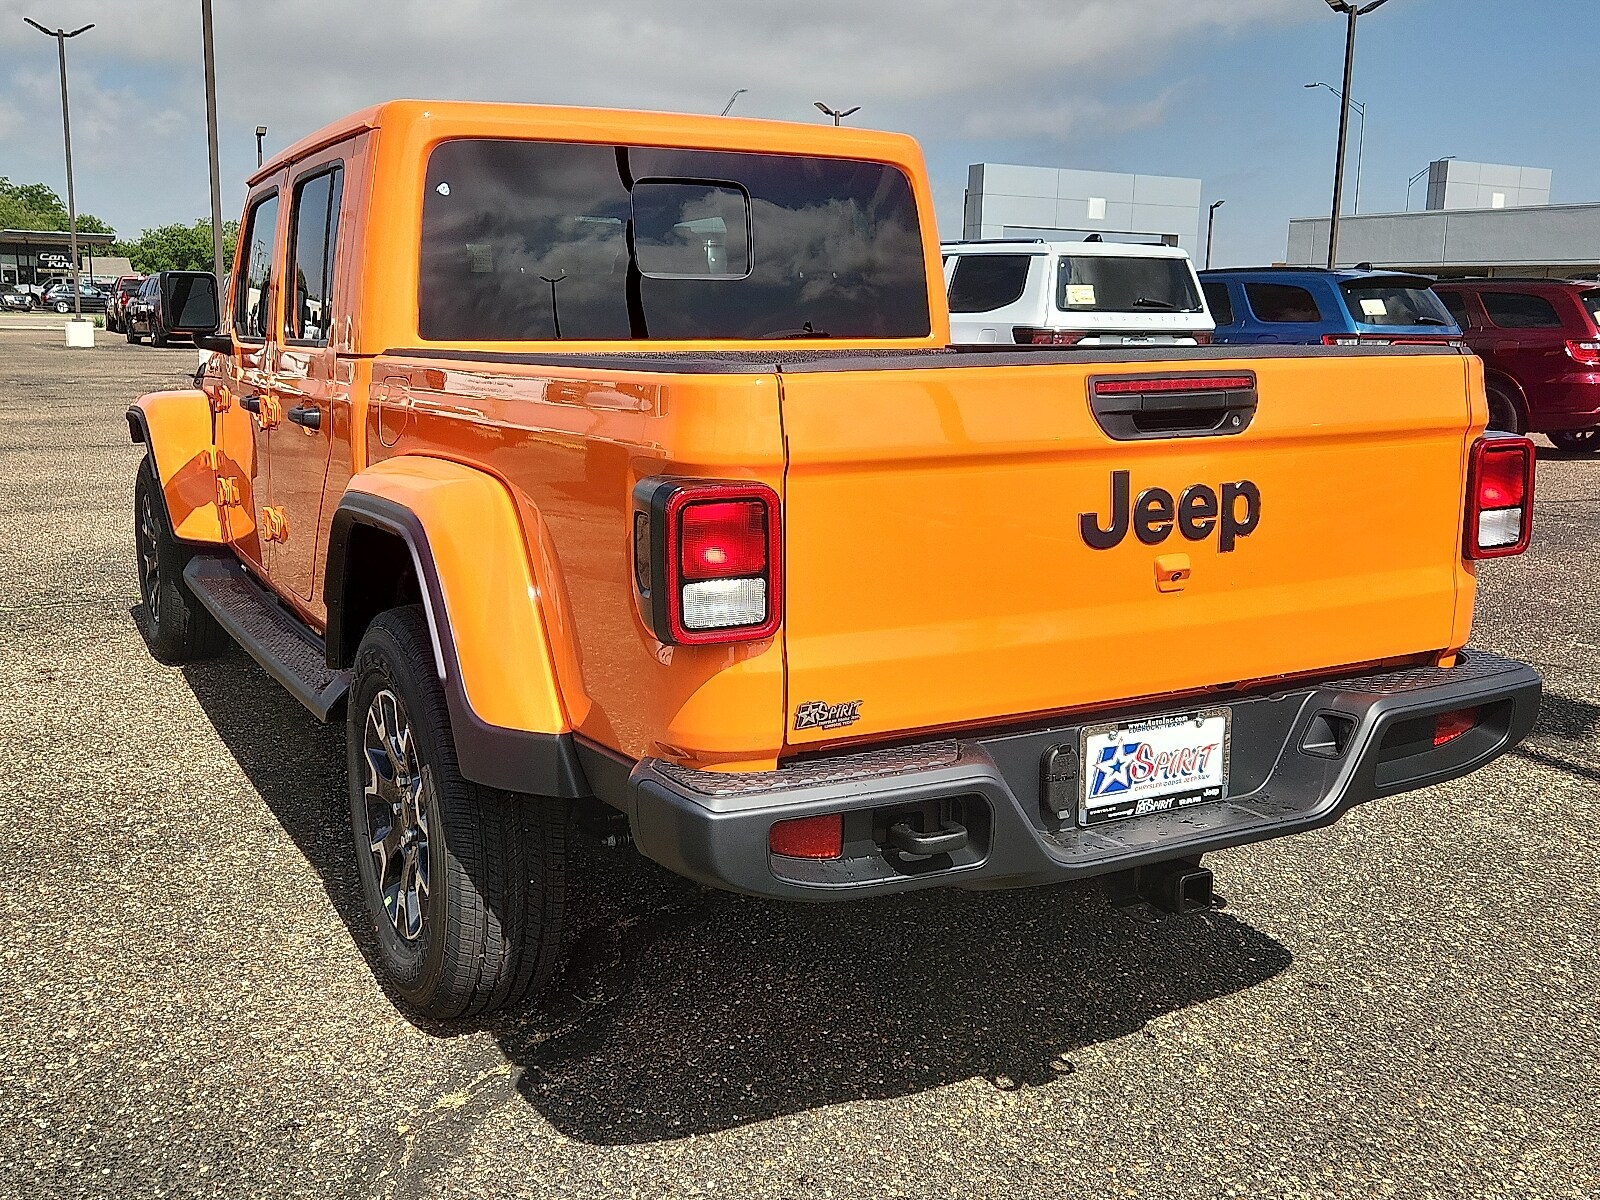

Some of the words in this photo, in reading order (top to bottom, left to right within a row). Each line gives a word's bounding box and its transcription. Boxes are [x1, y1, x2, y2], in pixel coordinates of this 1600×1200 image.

[1078, 470, 1261, 553] Jeep
[1131, 742, 1220, 783] SPIRIT
[1178, 796, 1202, 806] RAM
[1203, 788, 1220, 797] Jeep
